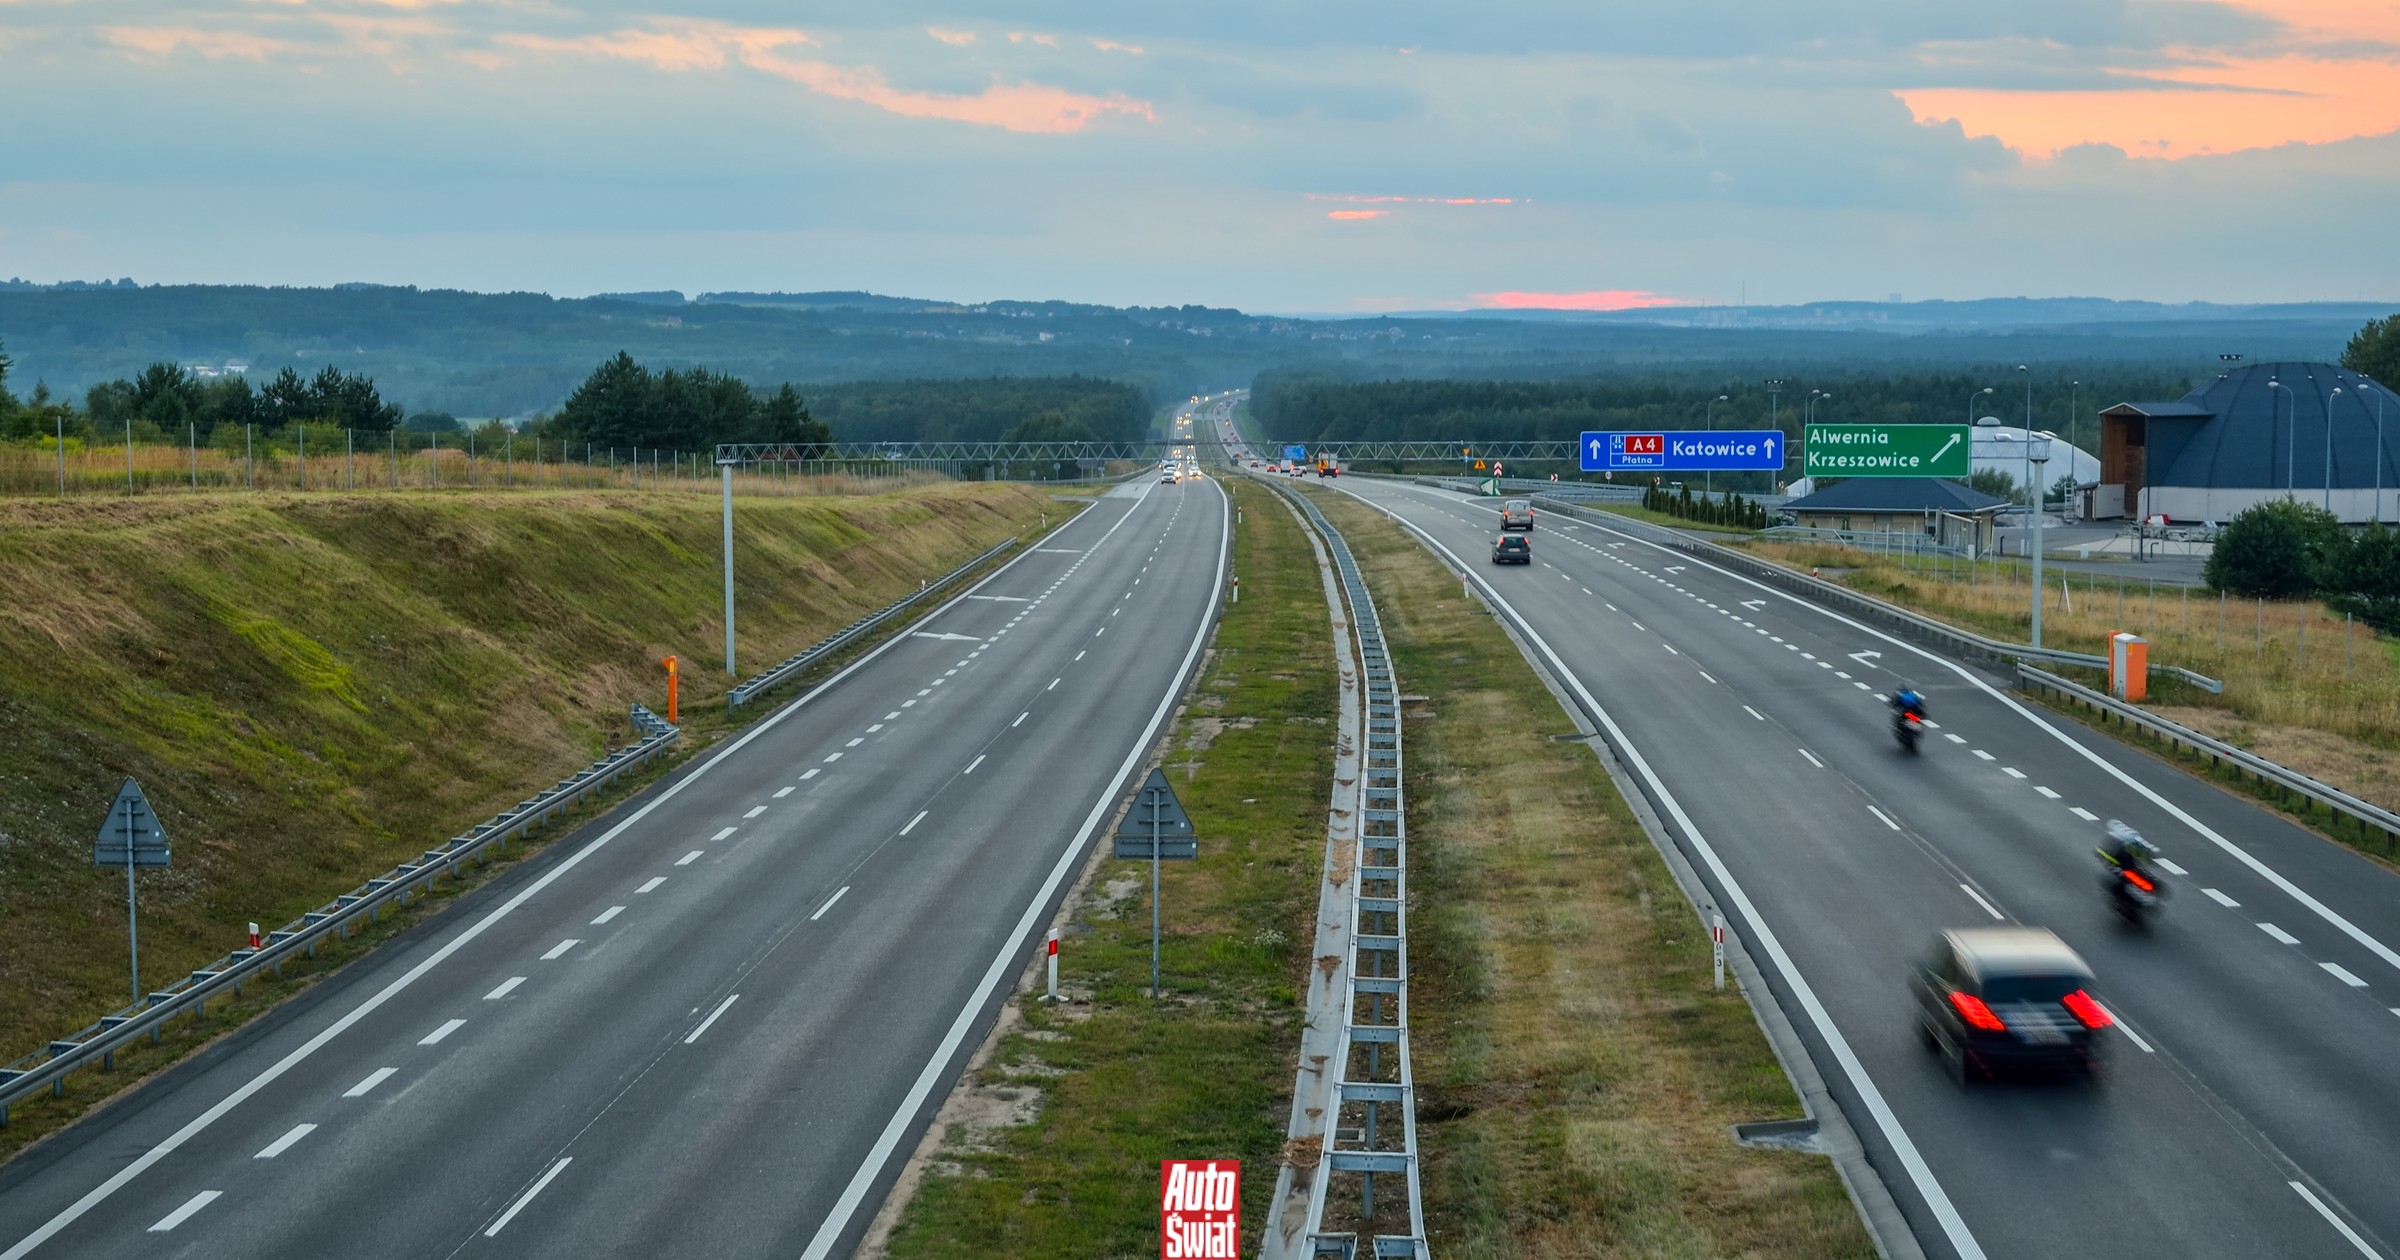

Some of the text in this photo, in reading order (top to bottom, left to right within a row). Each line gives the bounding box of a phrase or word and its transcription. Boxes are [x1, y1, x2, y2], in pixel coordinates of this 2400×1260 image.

[1810, 428, 1889, 444] Alwernia
[1673, 440, 1757, 456] Katowice
[1622, 455, 1653, 464] Płatna
[1808, 451, 1920, 467] Krzeszowice
